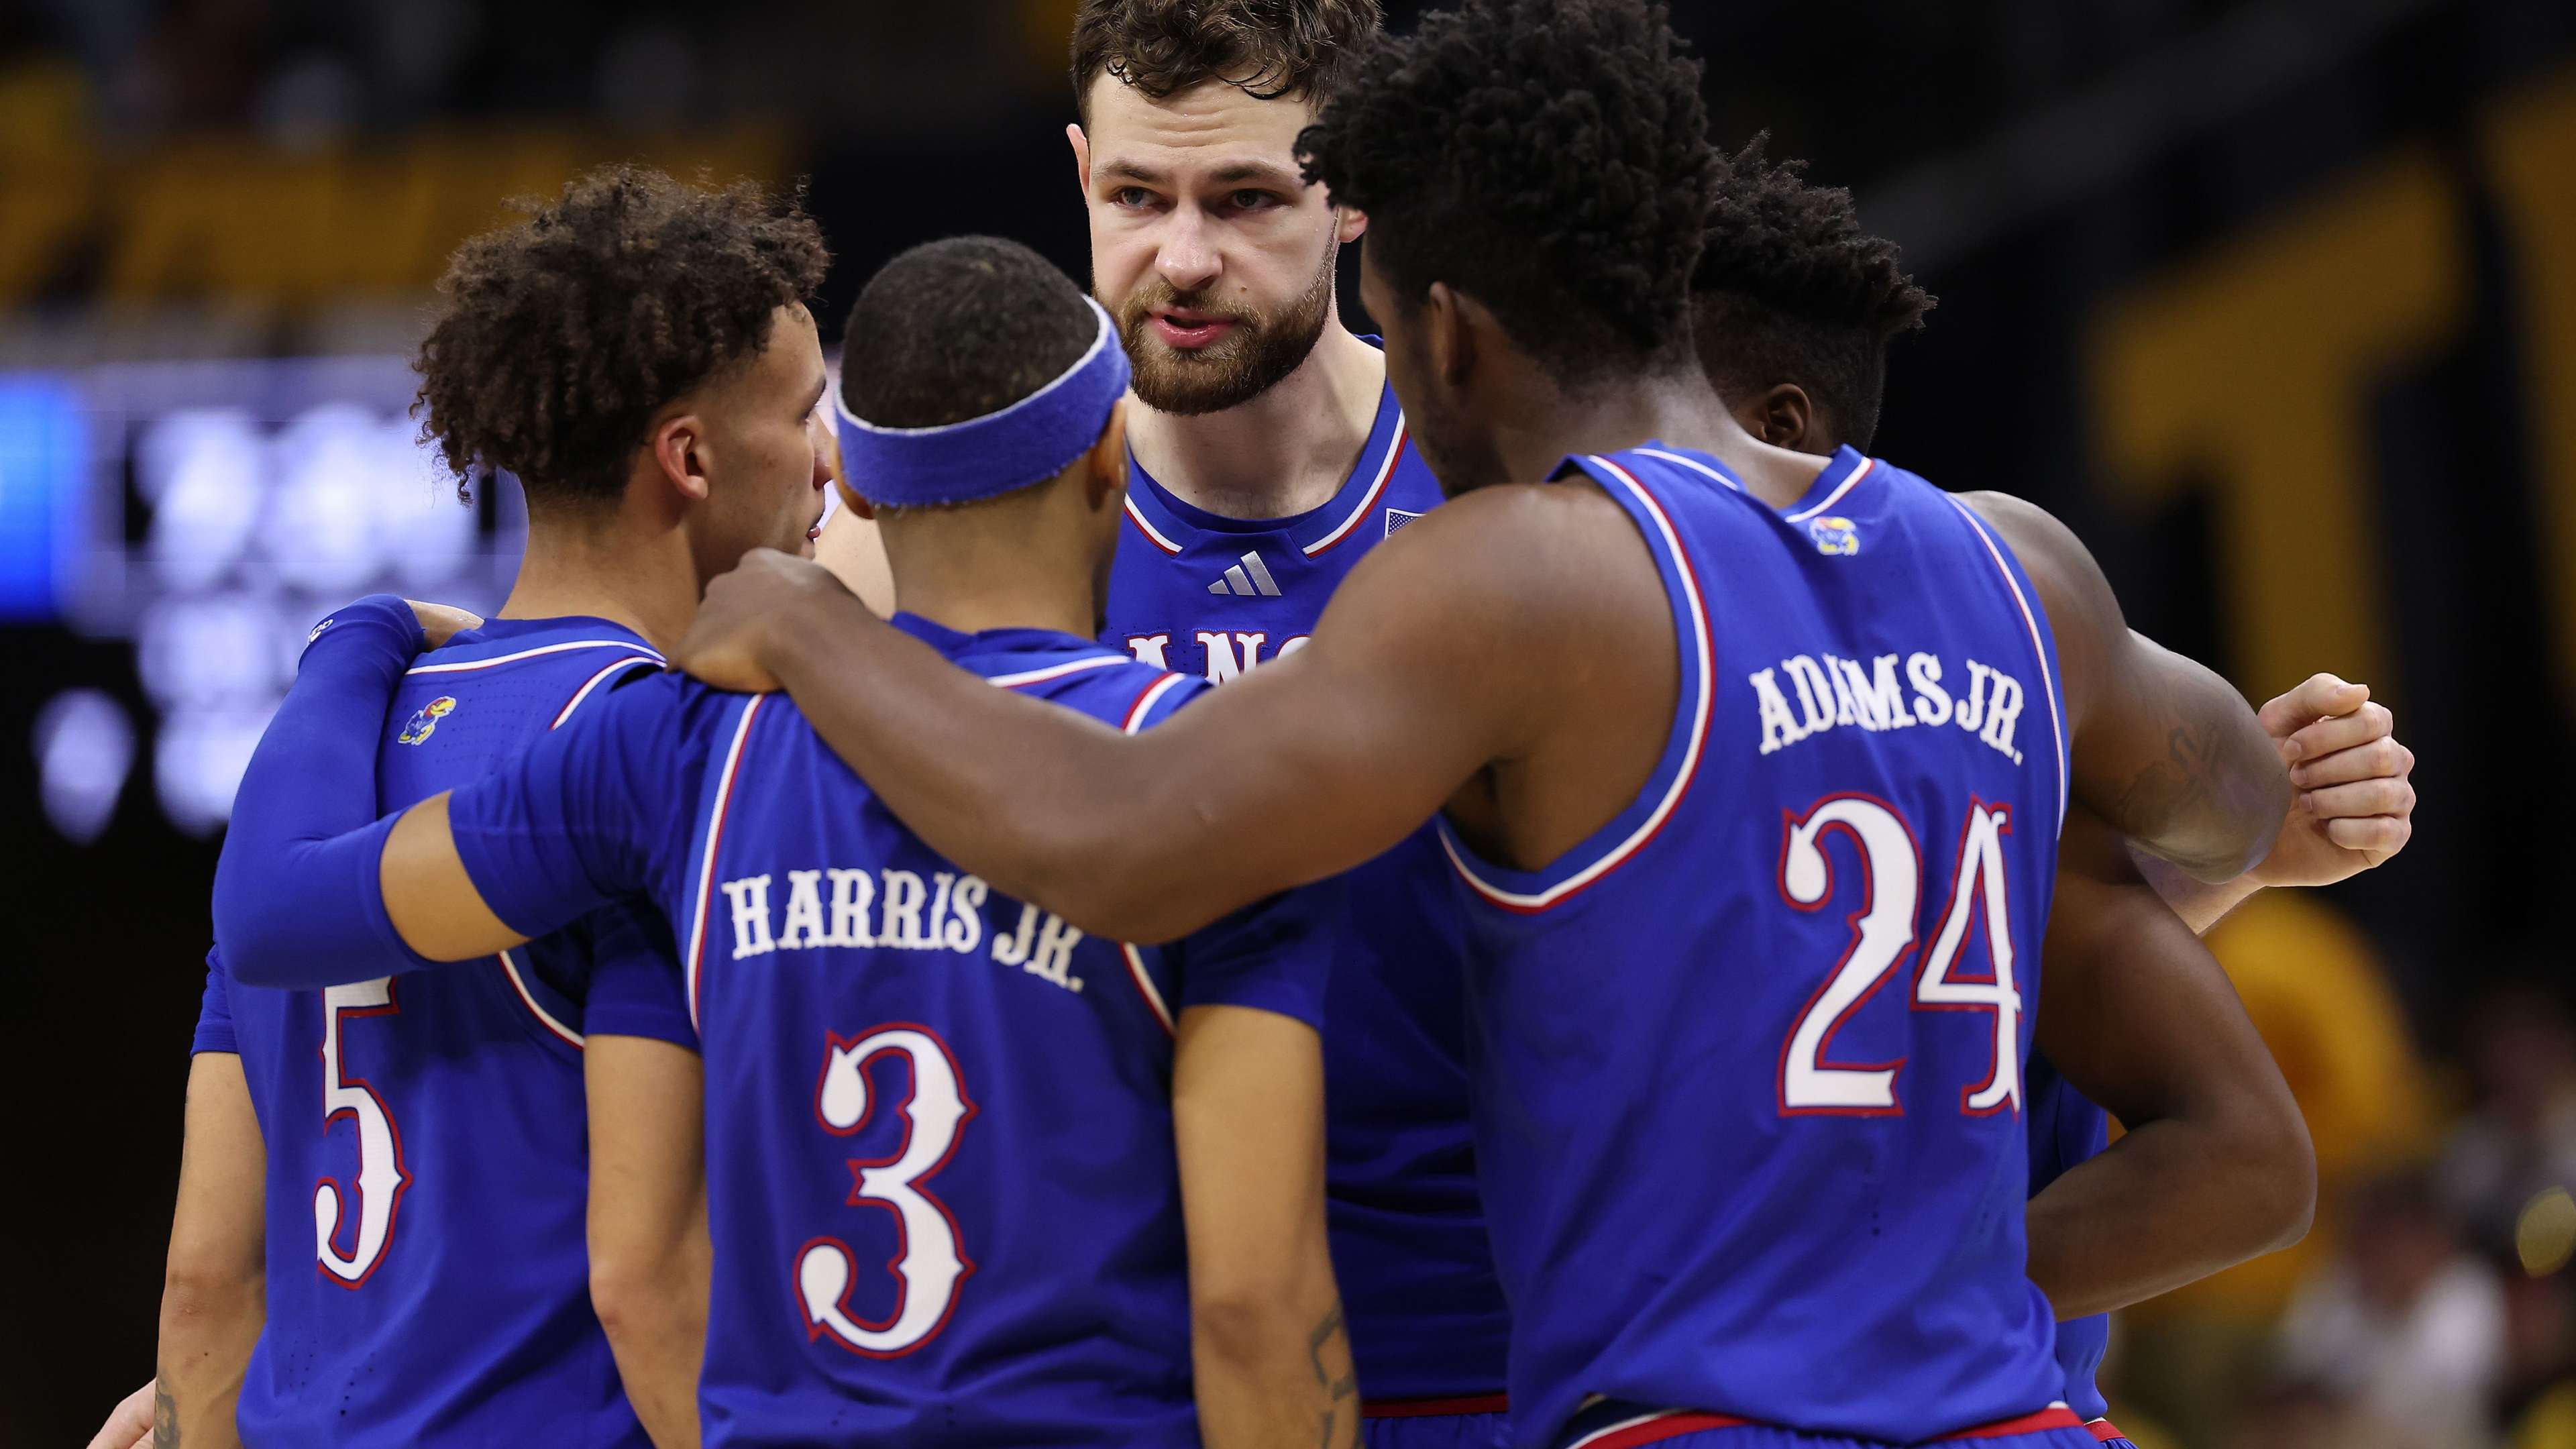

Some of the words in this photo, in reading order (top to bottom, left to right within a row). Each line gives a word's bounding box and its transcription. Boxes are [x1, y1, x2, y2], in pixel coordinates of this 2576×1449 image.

[1748, 651, 1953, 755] ADAMS
[1955, 658, 2025, 767] JR.
[720, 867, 989, 961] HARRIS
[991, 902, 1084, 992] JR.
[1777, 790, 2023, 1122] 24
[313, 975, 413, 1289] 5
[794, 1021, 979, 1360] 3
